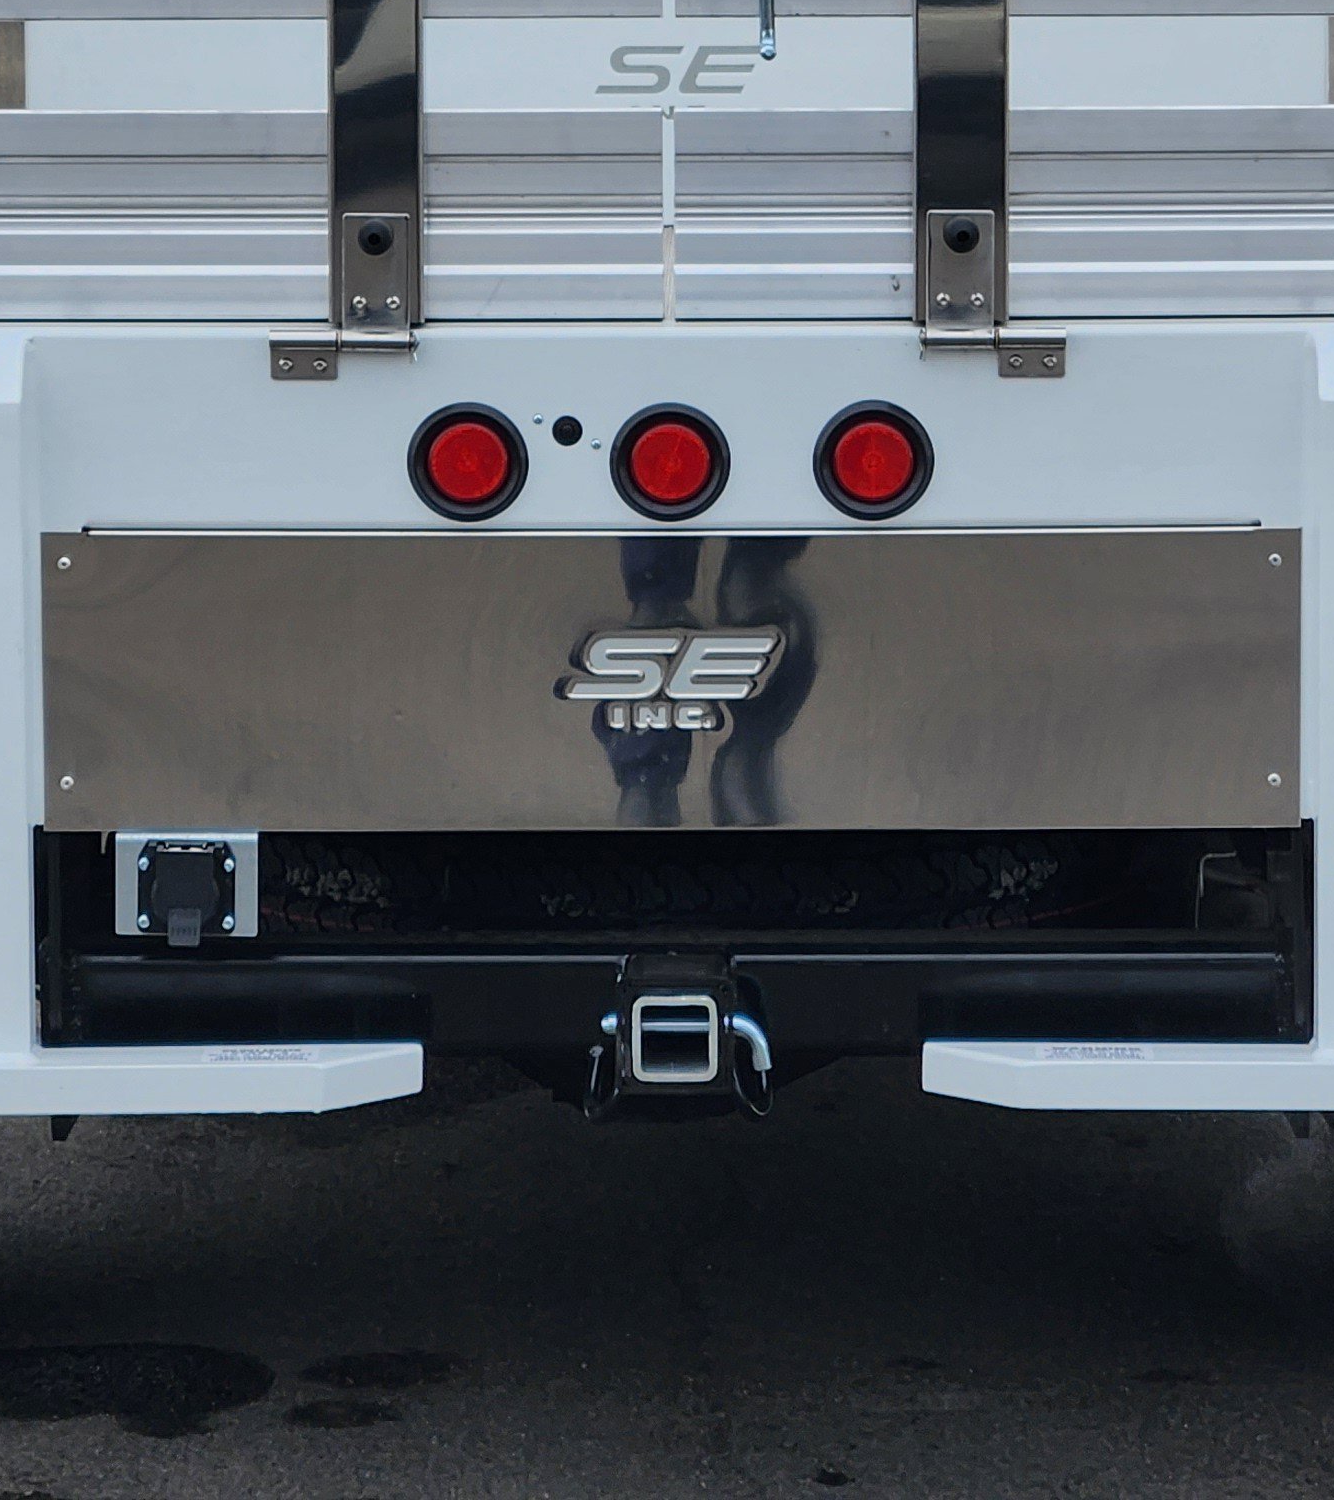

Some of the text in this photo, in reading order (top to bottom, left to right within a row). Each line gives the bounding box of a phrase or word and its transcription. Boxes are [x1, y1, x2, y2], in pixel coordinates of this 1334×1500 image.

[594, 45, 761, 94] SE
[566, 636, 779, 700] SE
[609, 706, 715, 729] INC.
